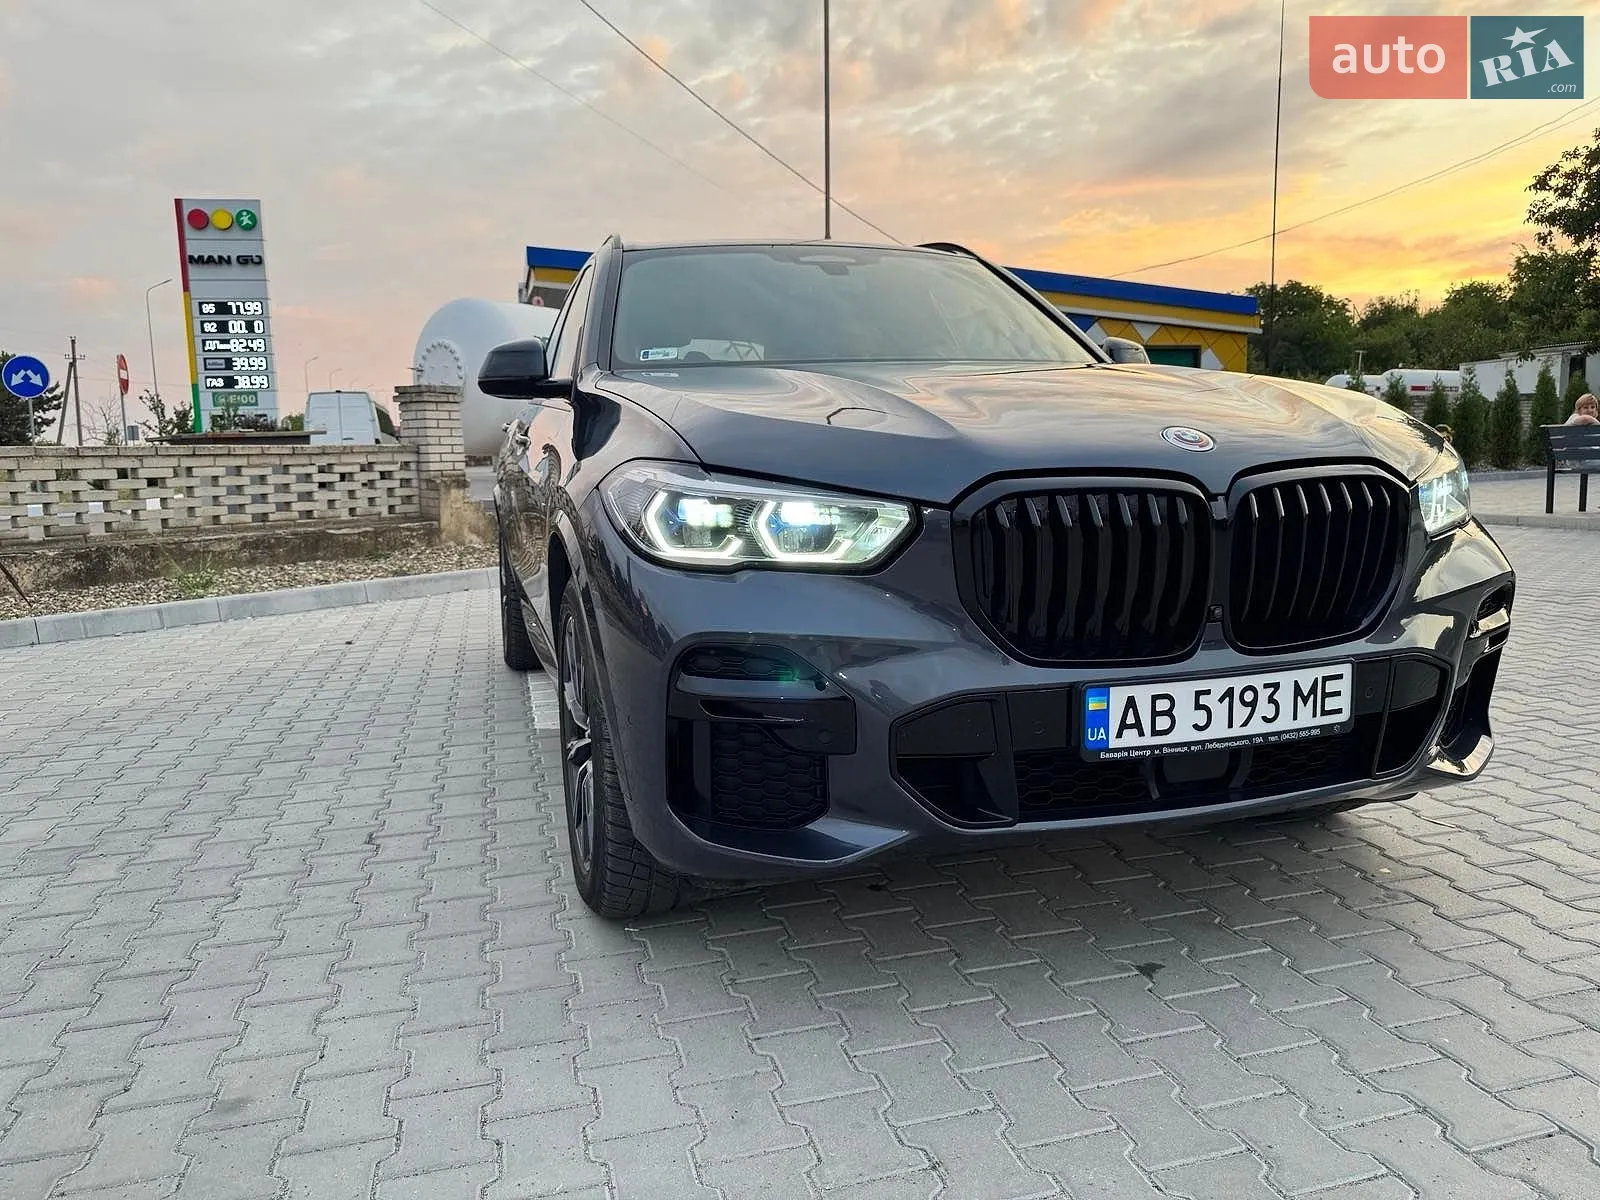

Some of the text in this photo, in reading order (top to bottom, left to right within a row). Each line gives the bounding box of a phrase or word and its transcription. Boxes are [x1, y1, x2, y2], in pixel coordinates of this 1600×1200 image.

[188, 255, 232, 265] MAN
[230, 338, 265, 352] 82.49
[232, 356, 267, 371] 39.99
[206, 378, 225, 388] ГАЗ
[1088, 673, 1344, 741] UA AB 5193 ME
[1100, 750, 1128, 760] Баварія
[1129, 749, 1151, 758] Центр
